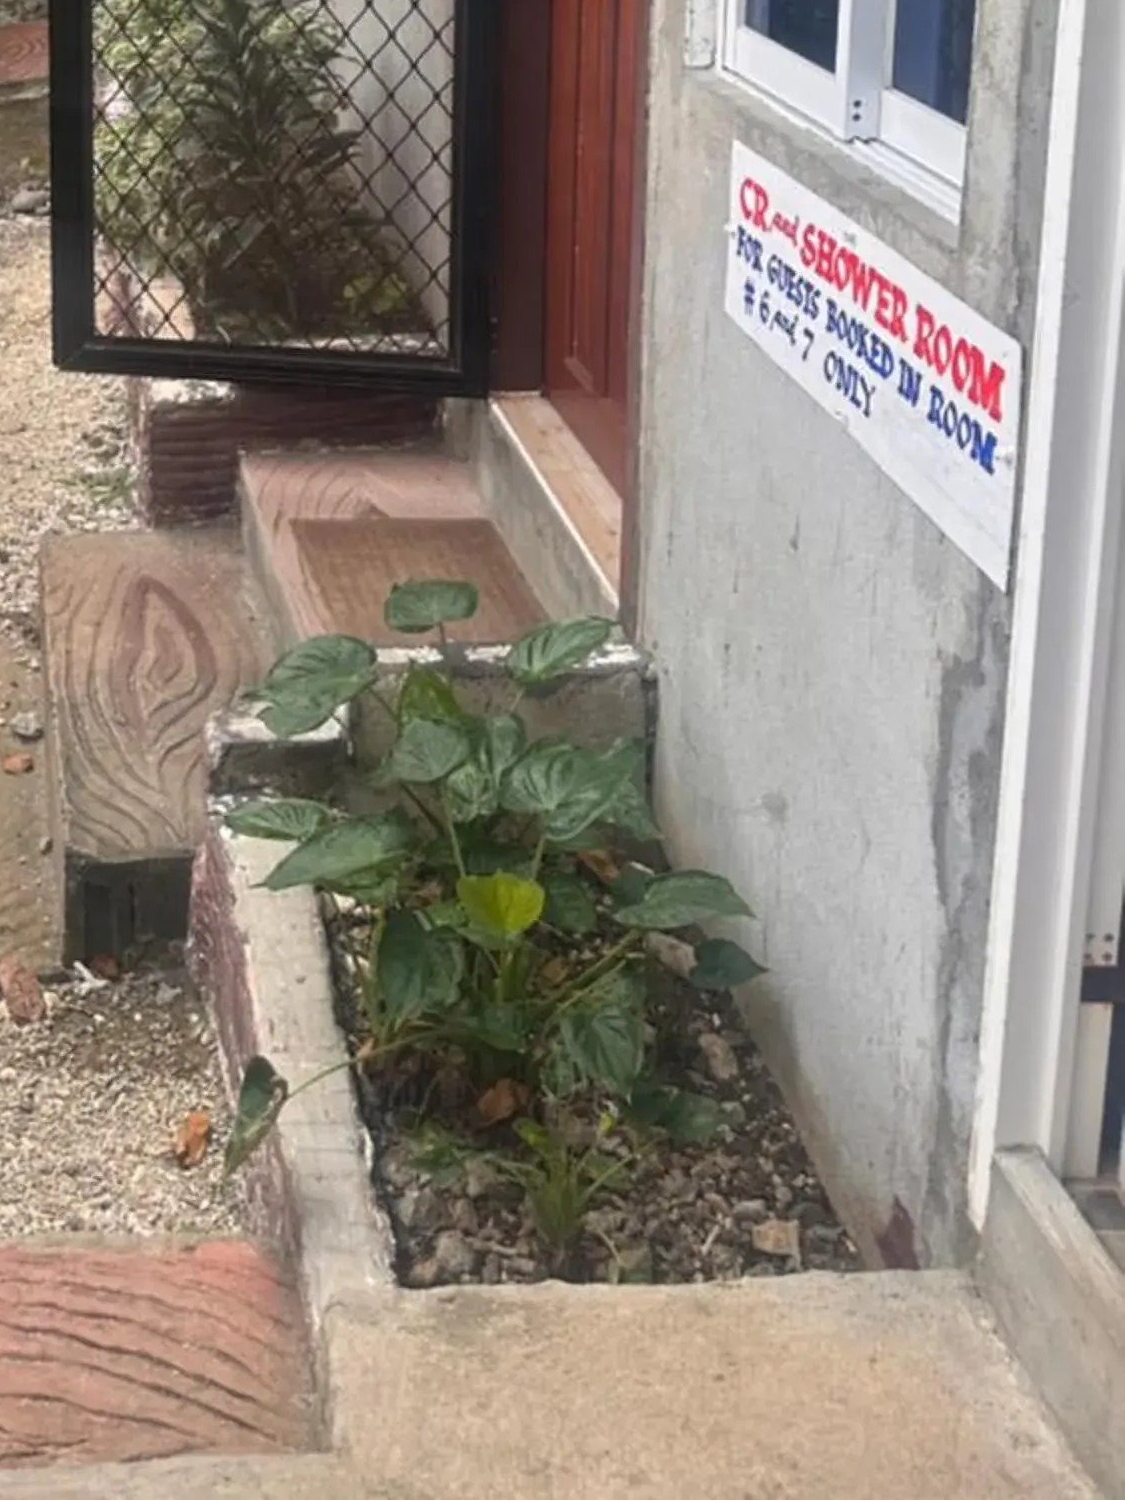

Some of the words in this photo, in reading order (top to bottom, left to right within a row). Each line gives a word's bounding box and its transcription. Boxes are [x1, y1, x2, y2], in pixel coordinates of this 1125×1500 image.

[736, 225, 763, 273] FOR
[767, 252, 821, 321] GUESTS
[826, 298, 895, 381] BOOKED
[898, 357, 921, 408] IN
[927, 384, 998, 476] ROOM
[739, 176, 769, 232] CR
[772, 212, 800, 248] and
[800, 223, 908, 343] SHOWER
[914, 303, 1005, 422] ROOM
[758, 291, 771, 325] 6
[771, 308, 798, 347] and
[802, 329, 815, 361] 7
[824, 352, 875, 419] ONLY
